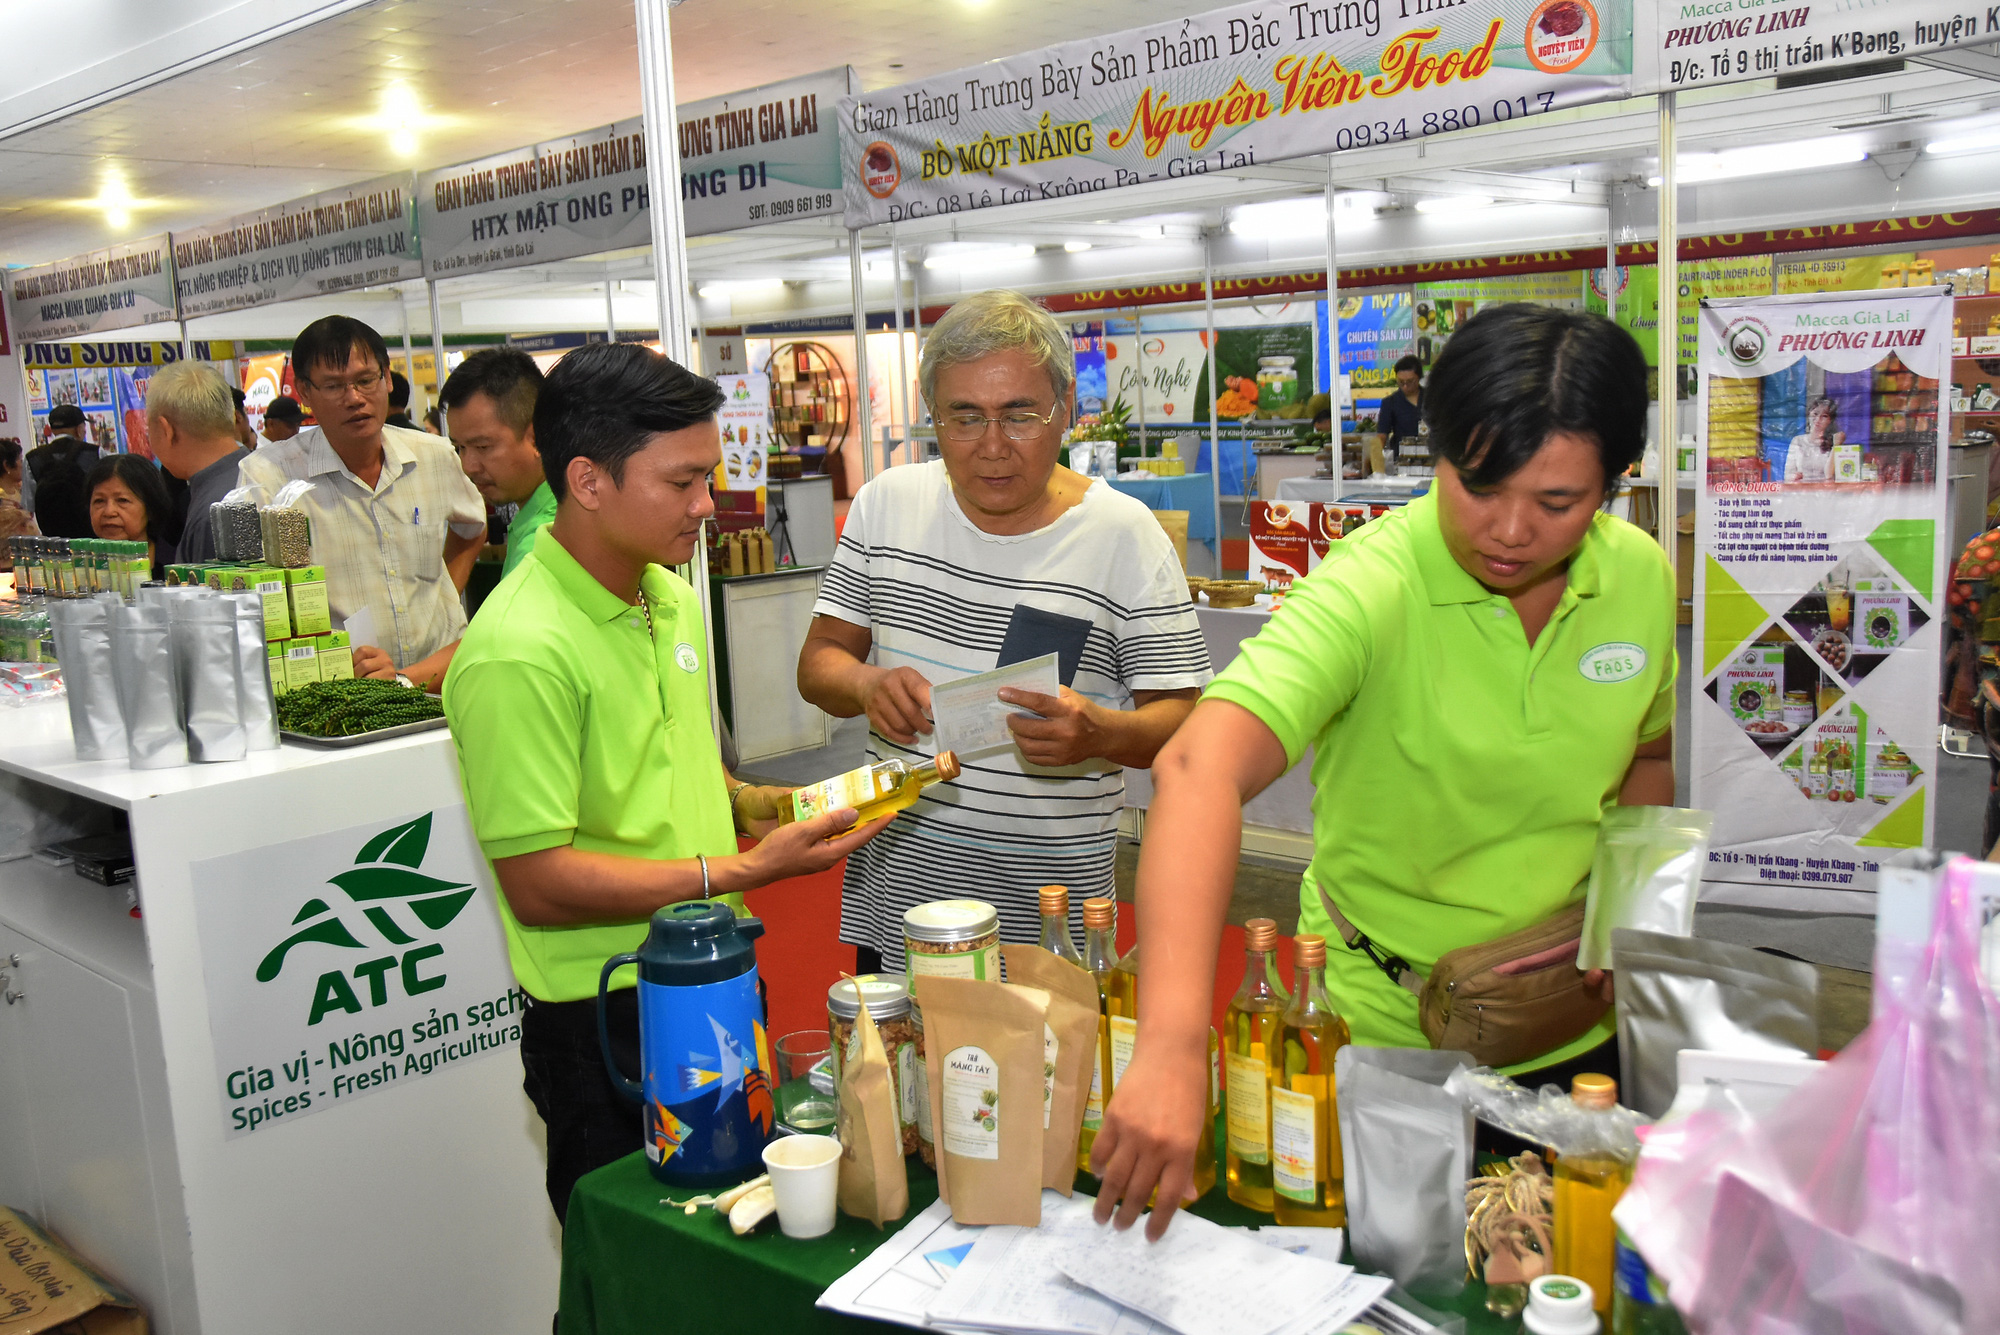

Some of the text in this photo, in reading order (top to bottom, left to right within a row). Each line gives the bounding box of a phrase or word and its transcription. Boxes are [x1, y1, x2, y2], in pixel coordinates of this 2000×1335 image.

[1664, 7, 1810, 49] PHƯƠNG LINH
[1680, 1, 1732, 20] Macca
[852, 103, 898, 134] Gian
[903, 89, 959, 126] Hàng
[965, 76, 1033, 111] Trưng
[1039, 58, 1083, 100] Bày
[1091, 45, 1138, 86] Sản
[1145, 18, 1219, 74] Phẩm
[1228, 11, 1281, 60] Đặc
[1290, 0, 1380, 41] Trưng
[1670, 58, 1704, 84] Đ/c:
[1710, 48, 1730, 77] Tổ
[1737, 50, 1748, 74] 9
[1754, 45, 1779, 72] thị
[1785, 36, 1823, 66] trấn
[1915, 14, 1977, 46] huyện
[1108, 20, 1501, 157] Nguyên Viên Food
[922, 113, 1092, 179] BÒ MỘT NẮNG
[1336, 91, 1555, 150] 0934 880 017
[435, 178, 461, 213] GIAN
[463, 168, 495, 207] HÀNG
[495, 159, 538, 199] TRƯNG
[538, 148, 562, 190] BÀY
[565, 139, 590, 184] SẢN
[592, 124, 630, 178] PHẨM
[679, 117, 712, 160] ƯNG
[715, 101, 755, 152] TỈNH
[758, 101, 786, 143] GIA
[789, 94, 818, 137] LAI
[936, 195, 961, 214] 08
[968, 189, 992, 209] Lê
[1114, 168, 1141, 188] Pa
[1168, 157, 1209, 178] Gia
[1217, 145, 1256, 169] Lai
[176, 241, 193, 269] GIAN
[345, 191, 368, 229] TỈNH
[369, 192, 385, 224] GIA
[385, 188, 402, 219] LAI
[471, 161, 767, 241] HTX MẬT ONG PHNG DI
[771, 199, 794, 217] 0909
[797, 198, 813, 212] 661
[816, 193, 832, 209] 919
[179, 231, 406, 298] HTX NÔNG NGHIỆP & DỊCH VỤ HÙNG THƠM GIA LAI
[1679, 271, 1722, 282] FAIRTRADE
[1723, 268, 1748, 279] INDER
[1750, 266, 1767, 277] FLO
[41, 290, 135, 321] MACCA MINH QUANG GIA LAI
[1347, 328, 1378, 343] CHUYÊN
[1795, 309, 1910, 327] Macca Gia Lai
[1778, 328, 1926, 352] PHƯƠNG LINH
[1714, 480, 1744, 493] CÔNG
[1733, 853, 1738, 863] 9
[1745, 853, 1757, 866] Thị
[1775, 856, 1799, 868] Kbang
[1806, 858, 1829, 871] Huyện
[1831, 859, 1856, 871] Kbang
[1760, 868, 1777, 880] Điện
[307, 942, 447, 1026] ATC
[227, 988, 524, 1100] Gia vị Nông sản sạch
[231, 1024, 522, 1131] Spices Fresh Agricultura
